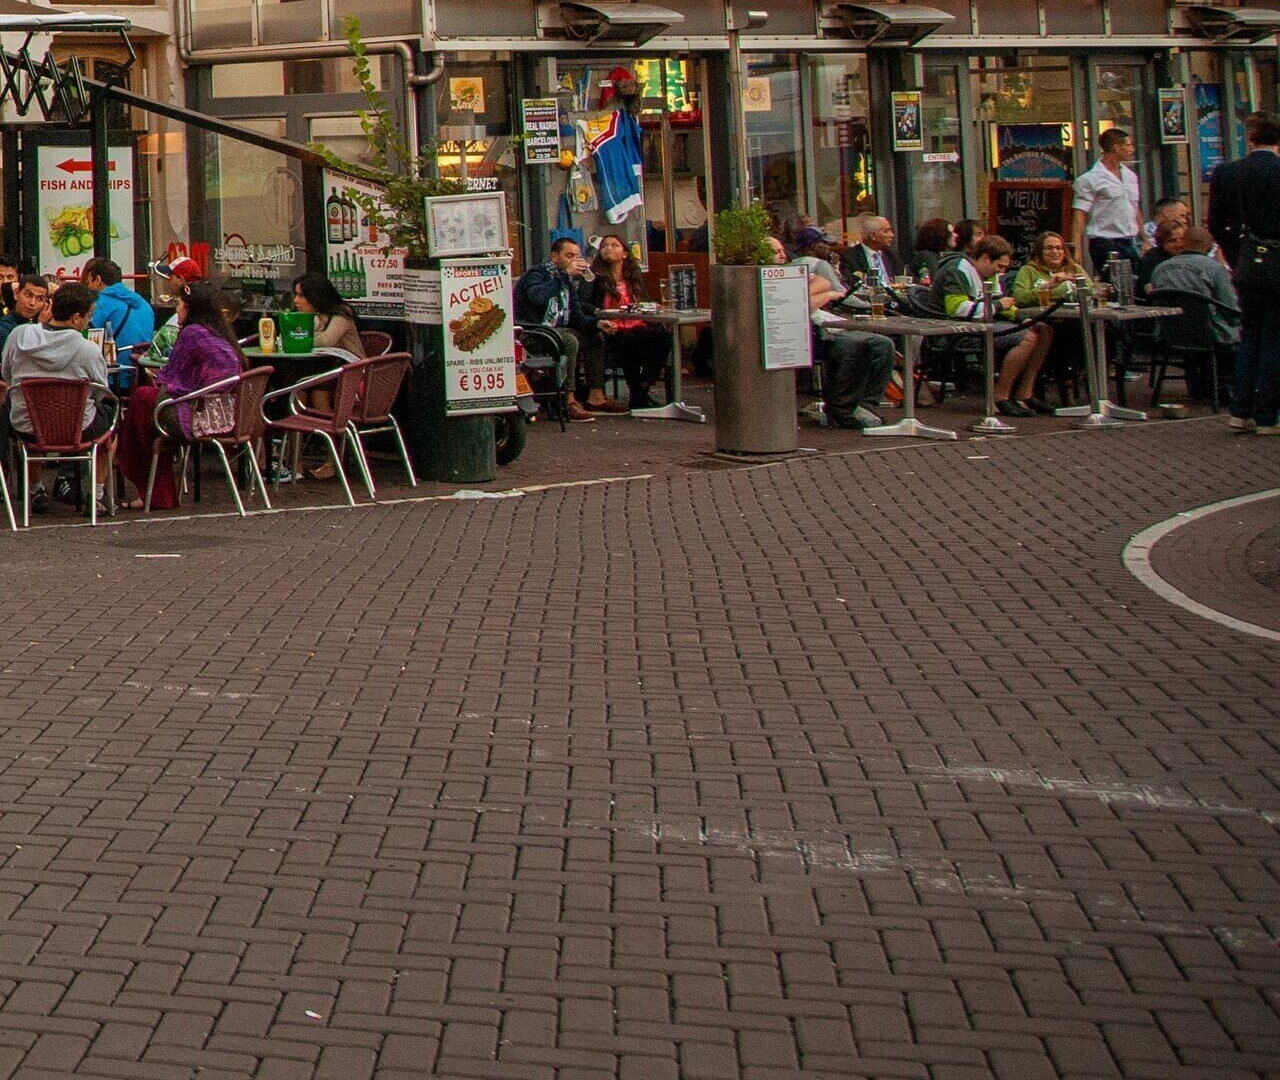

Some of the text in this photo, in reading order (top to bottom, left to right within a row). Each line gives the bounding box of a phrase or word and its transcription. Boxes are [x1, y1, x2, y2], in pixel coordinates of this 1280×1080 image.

[526, 121, 557, 131] REAL MADRID
[526, 136, 558, 146] BARCELONA
[40, 179, 131, 190] FISH AND HIPS
[466, 177, 500, 191] ERNET
[1005, 189, 1049, 211] MENU
[370, 259, 399, 270] € 27,50
[455, 270, 480, 278] SPORTS
[762, 268, 785, 278] FOOD
[448, 276, 505, 309] ACTIE!!
[446, 360, 466, 368] SPARE
[484, 357, 515, 365] UNLIMITED
[459, 373, 506, 393] € 9,95
